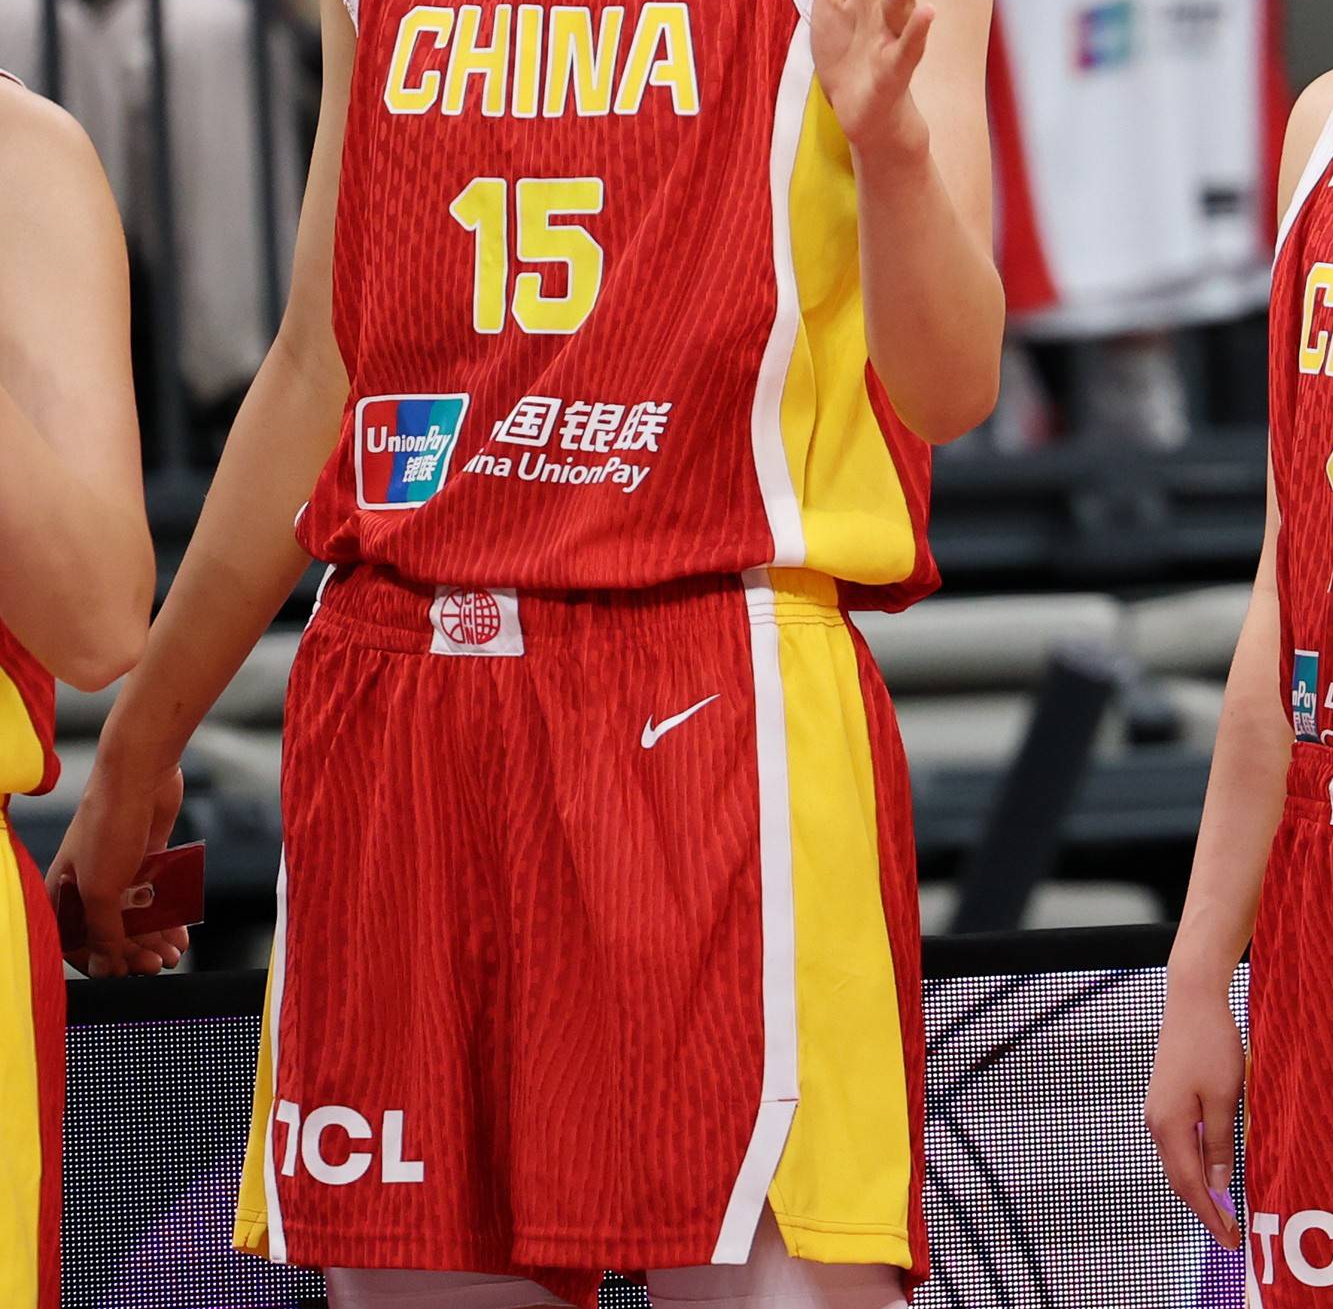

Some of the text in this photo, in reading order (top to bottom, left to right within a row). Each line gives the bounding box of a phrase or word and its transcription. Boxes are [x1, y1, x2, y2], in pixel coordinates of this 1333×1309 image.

[384, 2, 700, 119] CHINA
[449, 177, 603, 334] 15
[367, 425, 451, 462] UnionPay
[490, 396, 673, 453] 国银联
[518, 452, 650, 493] UnionPay
[276, 1099, 425, 1186] TCL
